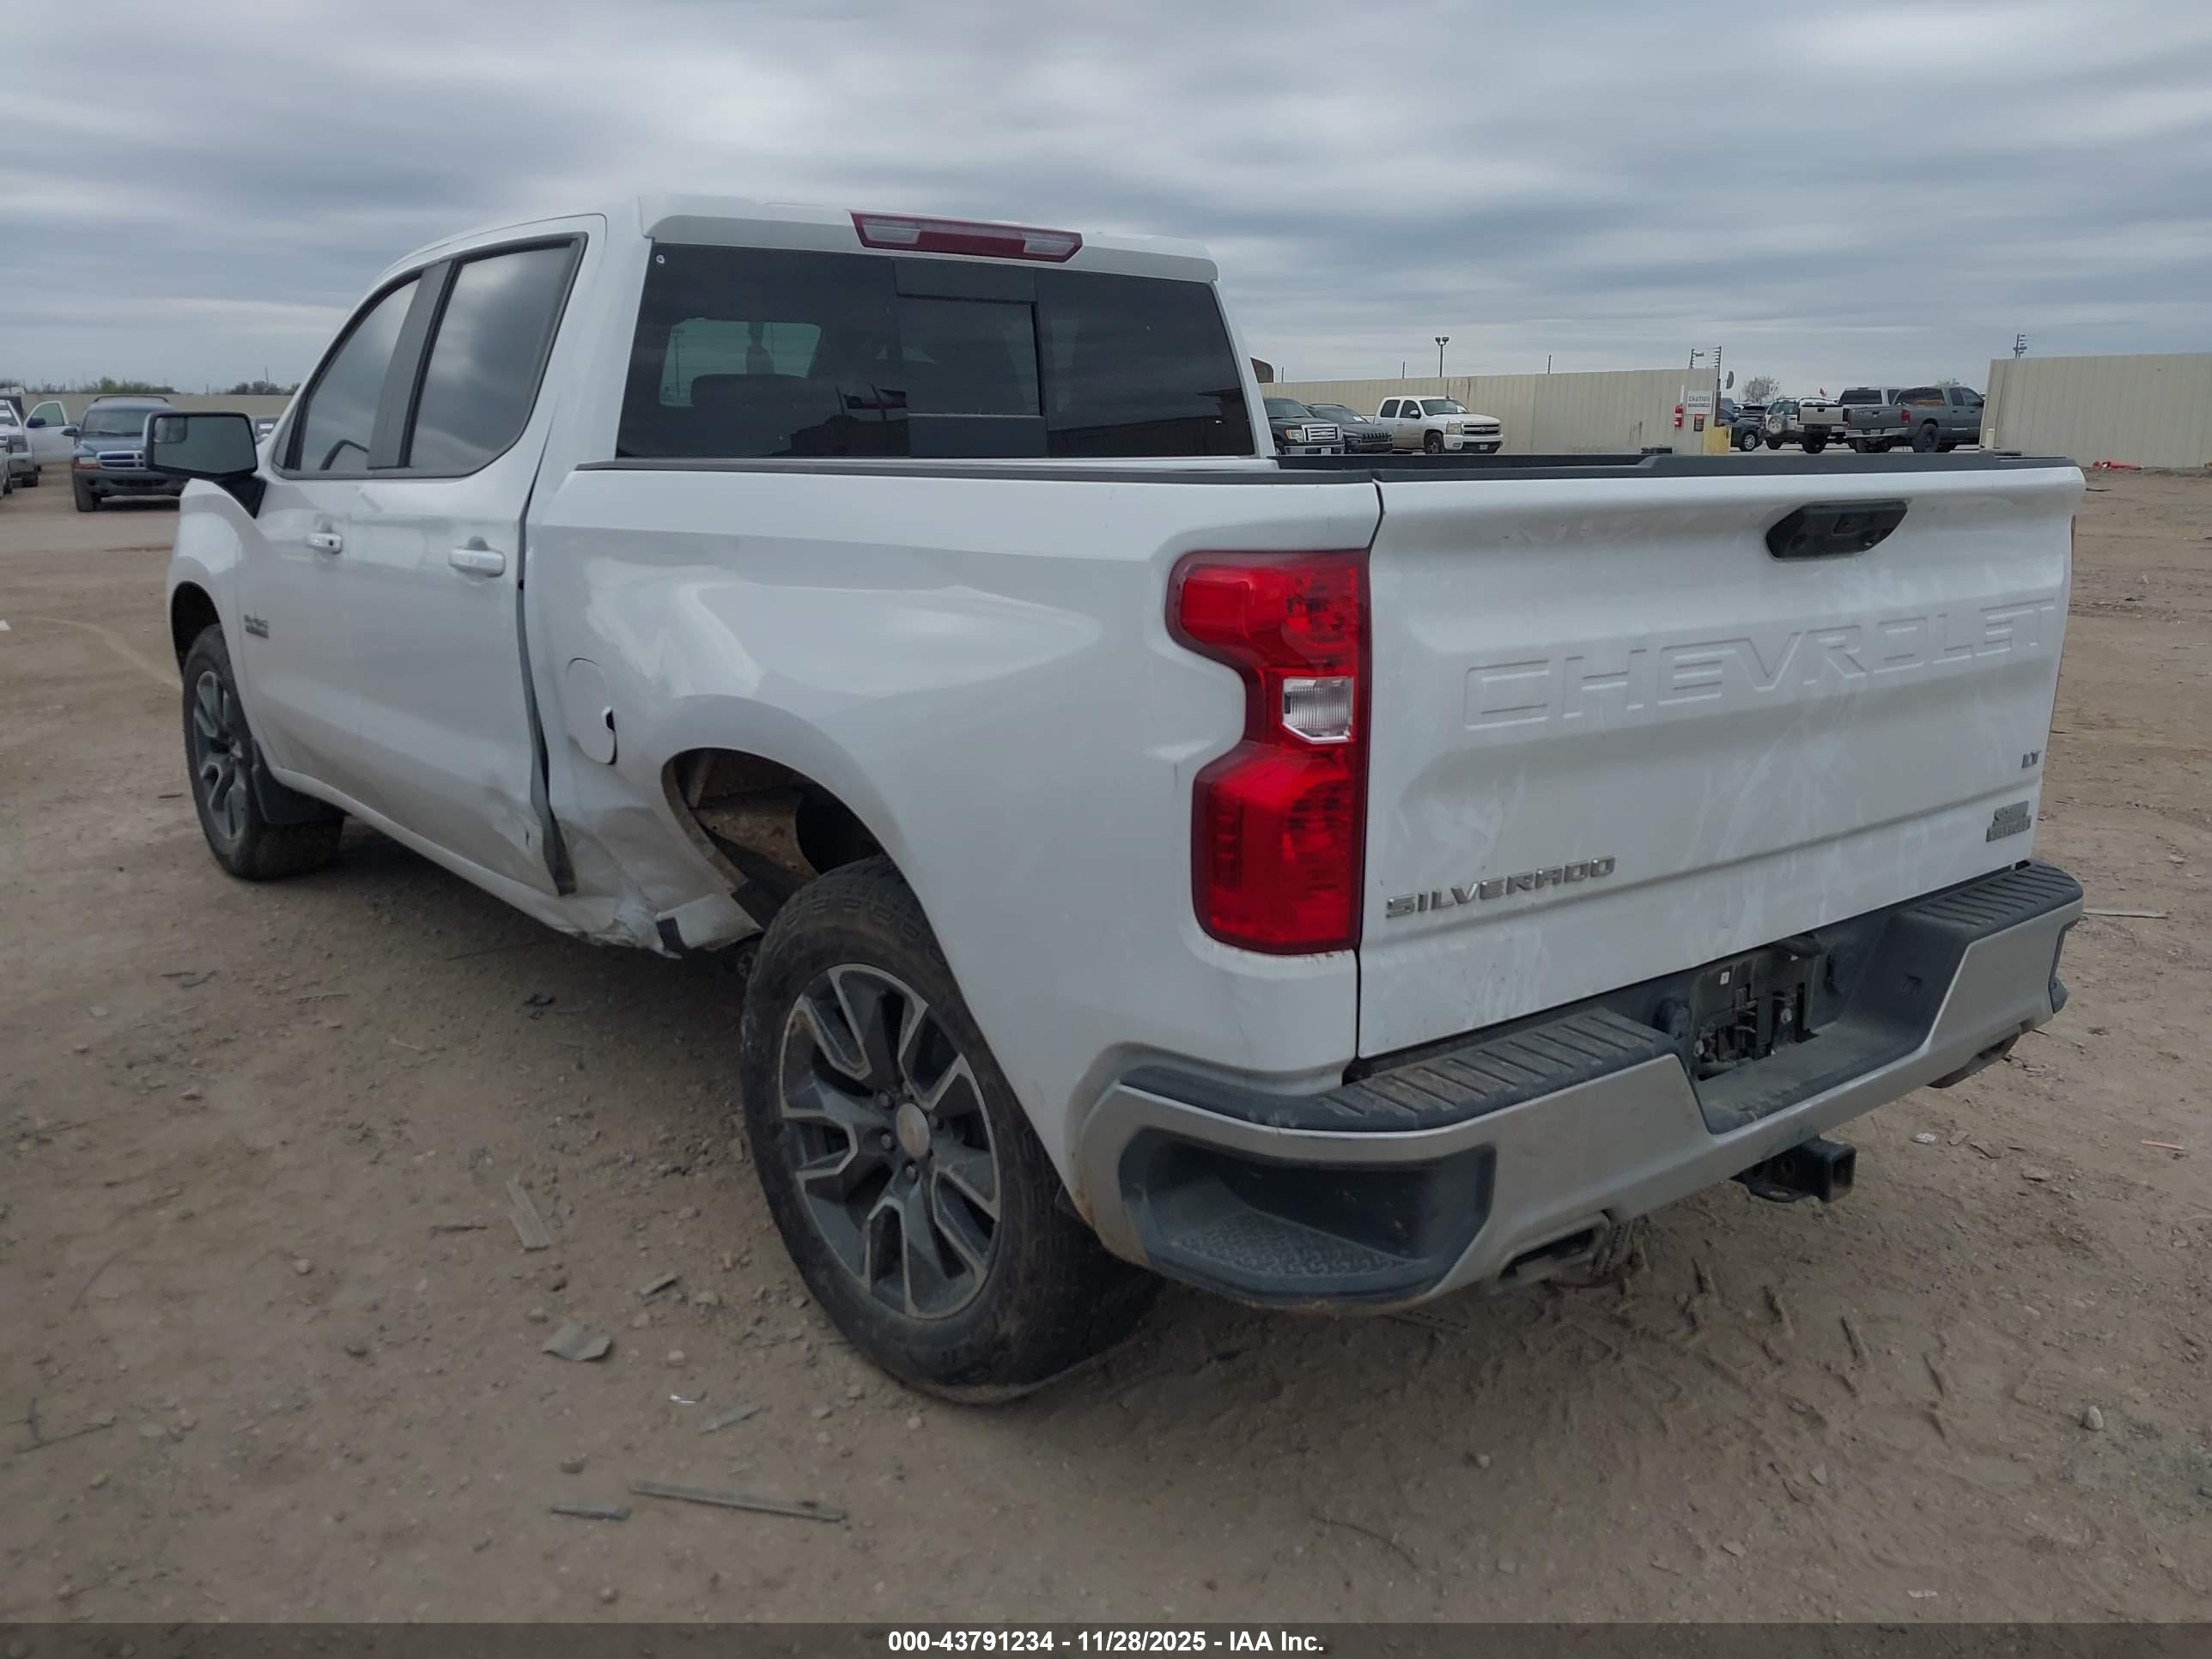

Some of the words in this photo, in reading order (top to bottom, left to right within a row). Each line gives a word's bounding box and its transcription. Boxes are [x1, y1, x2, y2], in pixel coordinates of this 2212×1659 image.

[1464, 599, 2057, 732] CHEVROLET
[2021, 750, 2041, 769] LT
[1386, 856, 1615, 919] SILVERADO
